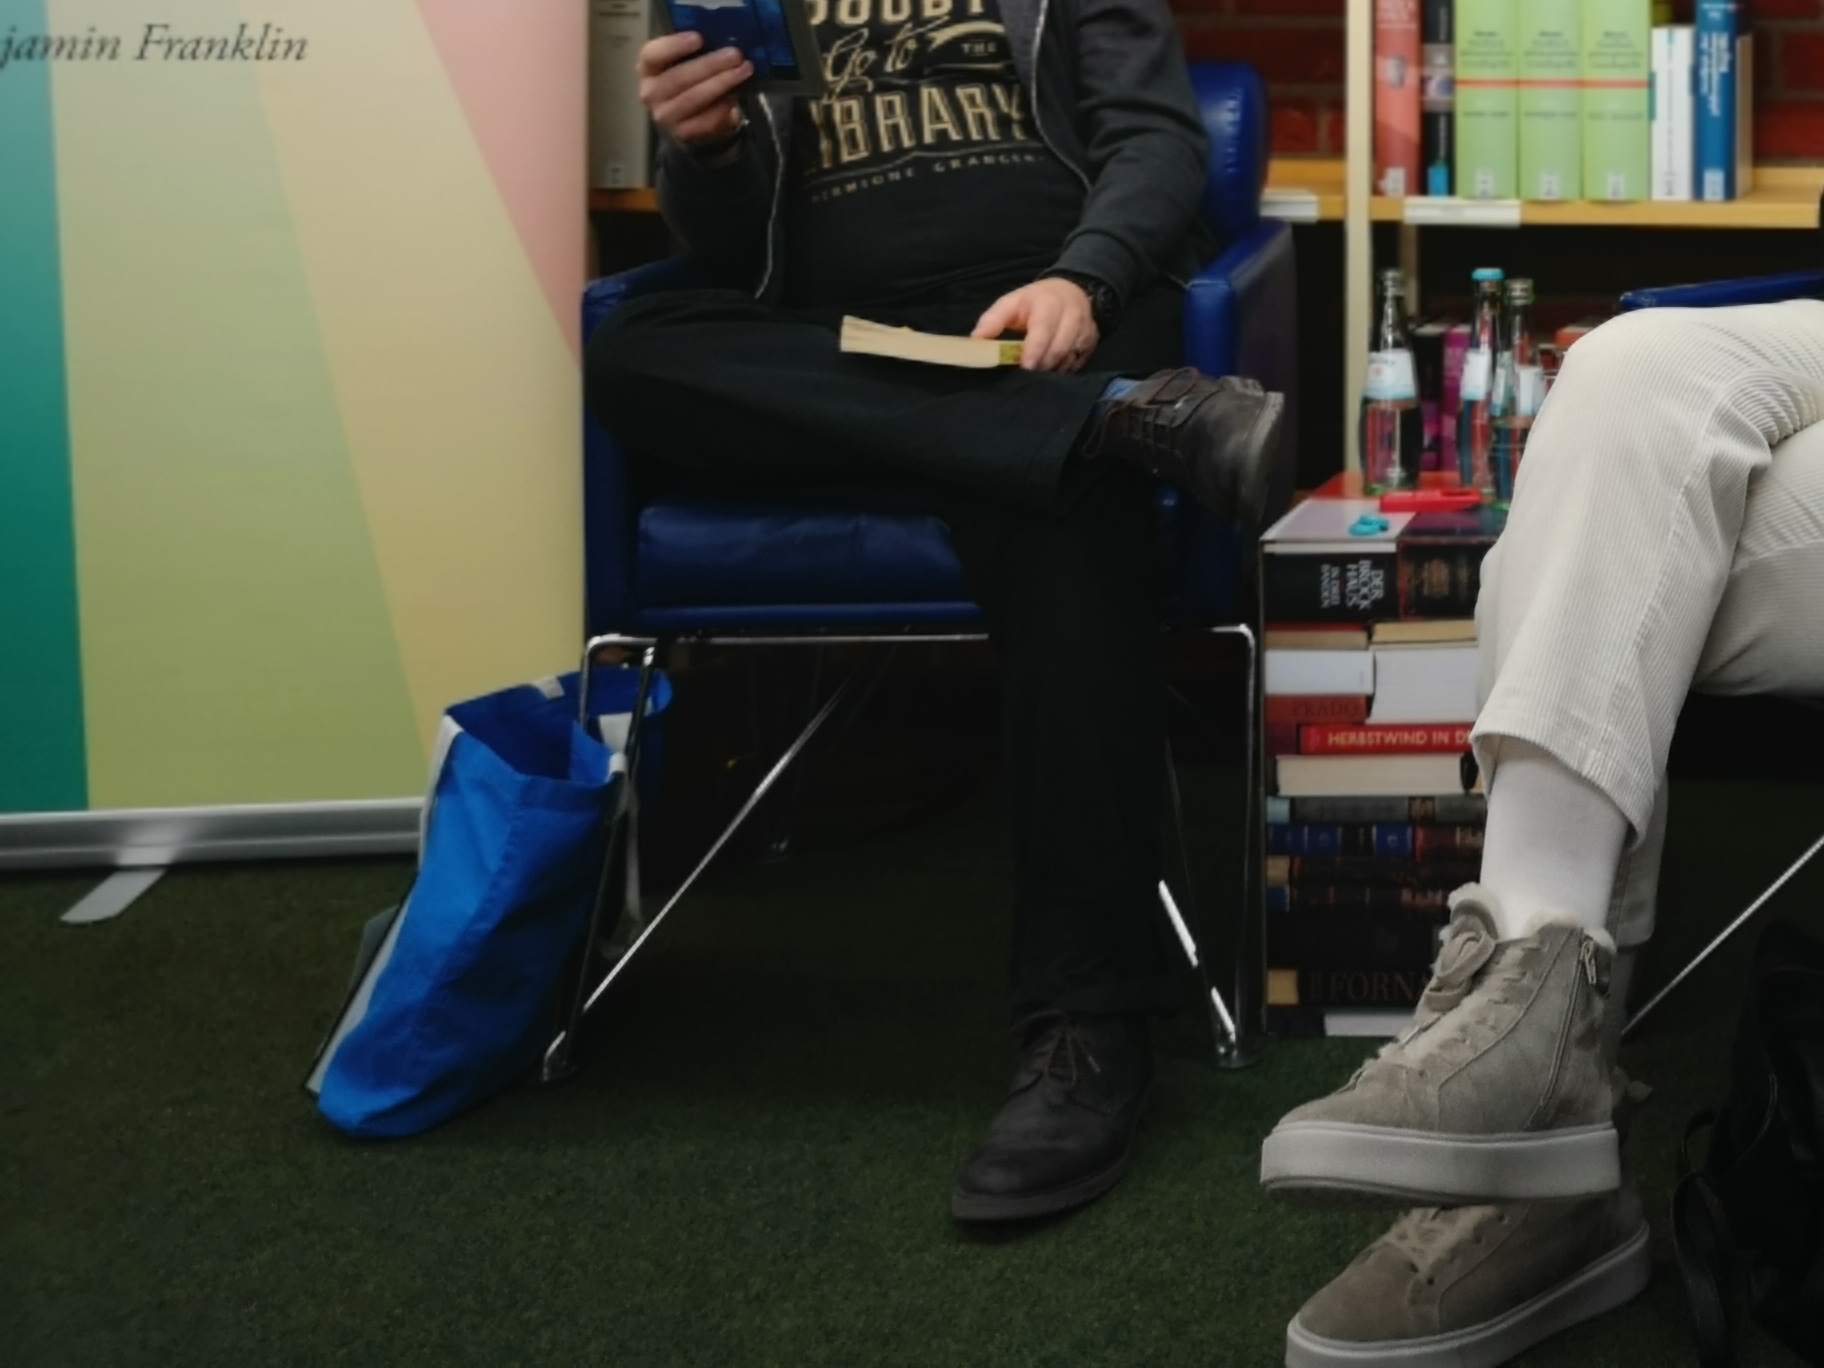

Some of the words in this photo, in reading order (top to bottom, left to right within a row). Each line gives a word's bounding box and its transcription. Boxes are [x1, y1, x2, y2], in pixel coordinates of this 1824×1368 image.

[135, 23, 308, 64] Franklin
[823, 27, 877, 105] Go
[884, 17, 950, 73] to
[961, 42, 998, 55] THE
[805, 84, 1027, 172] IBRARY
[1346, 564, 1358, 608] HAUS
[1358, 560, 1371, 611] BROCK
[1370, 570, 1384, 600] DER
[1293, 702, 1359, 718] PRADO
[1328, 729, 1428, 746] HERBSTWIND
[1432, 728, 1449, 744] IN
